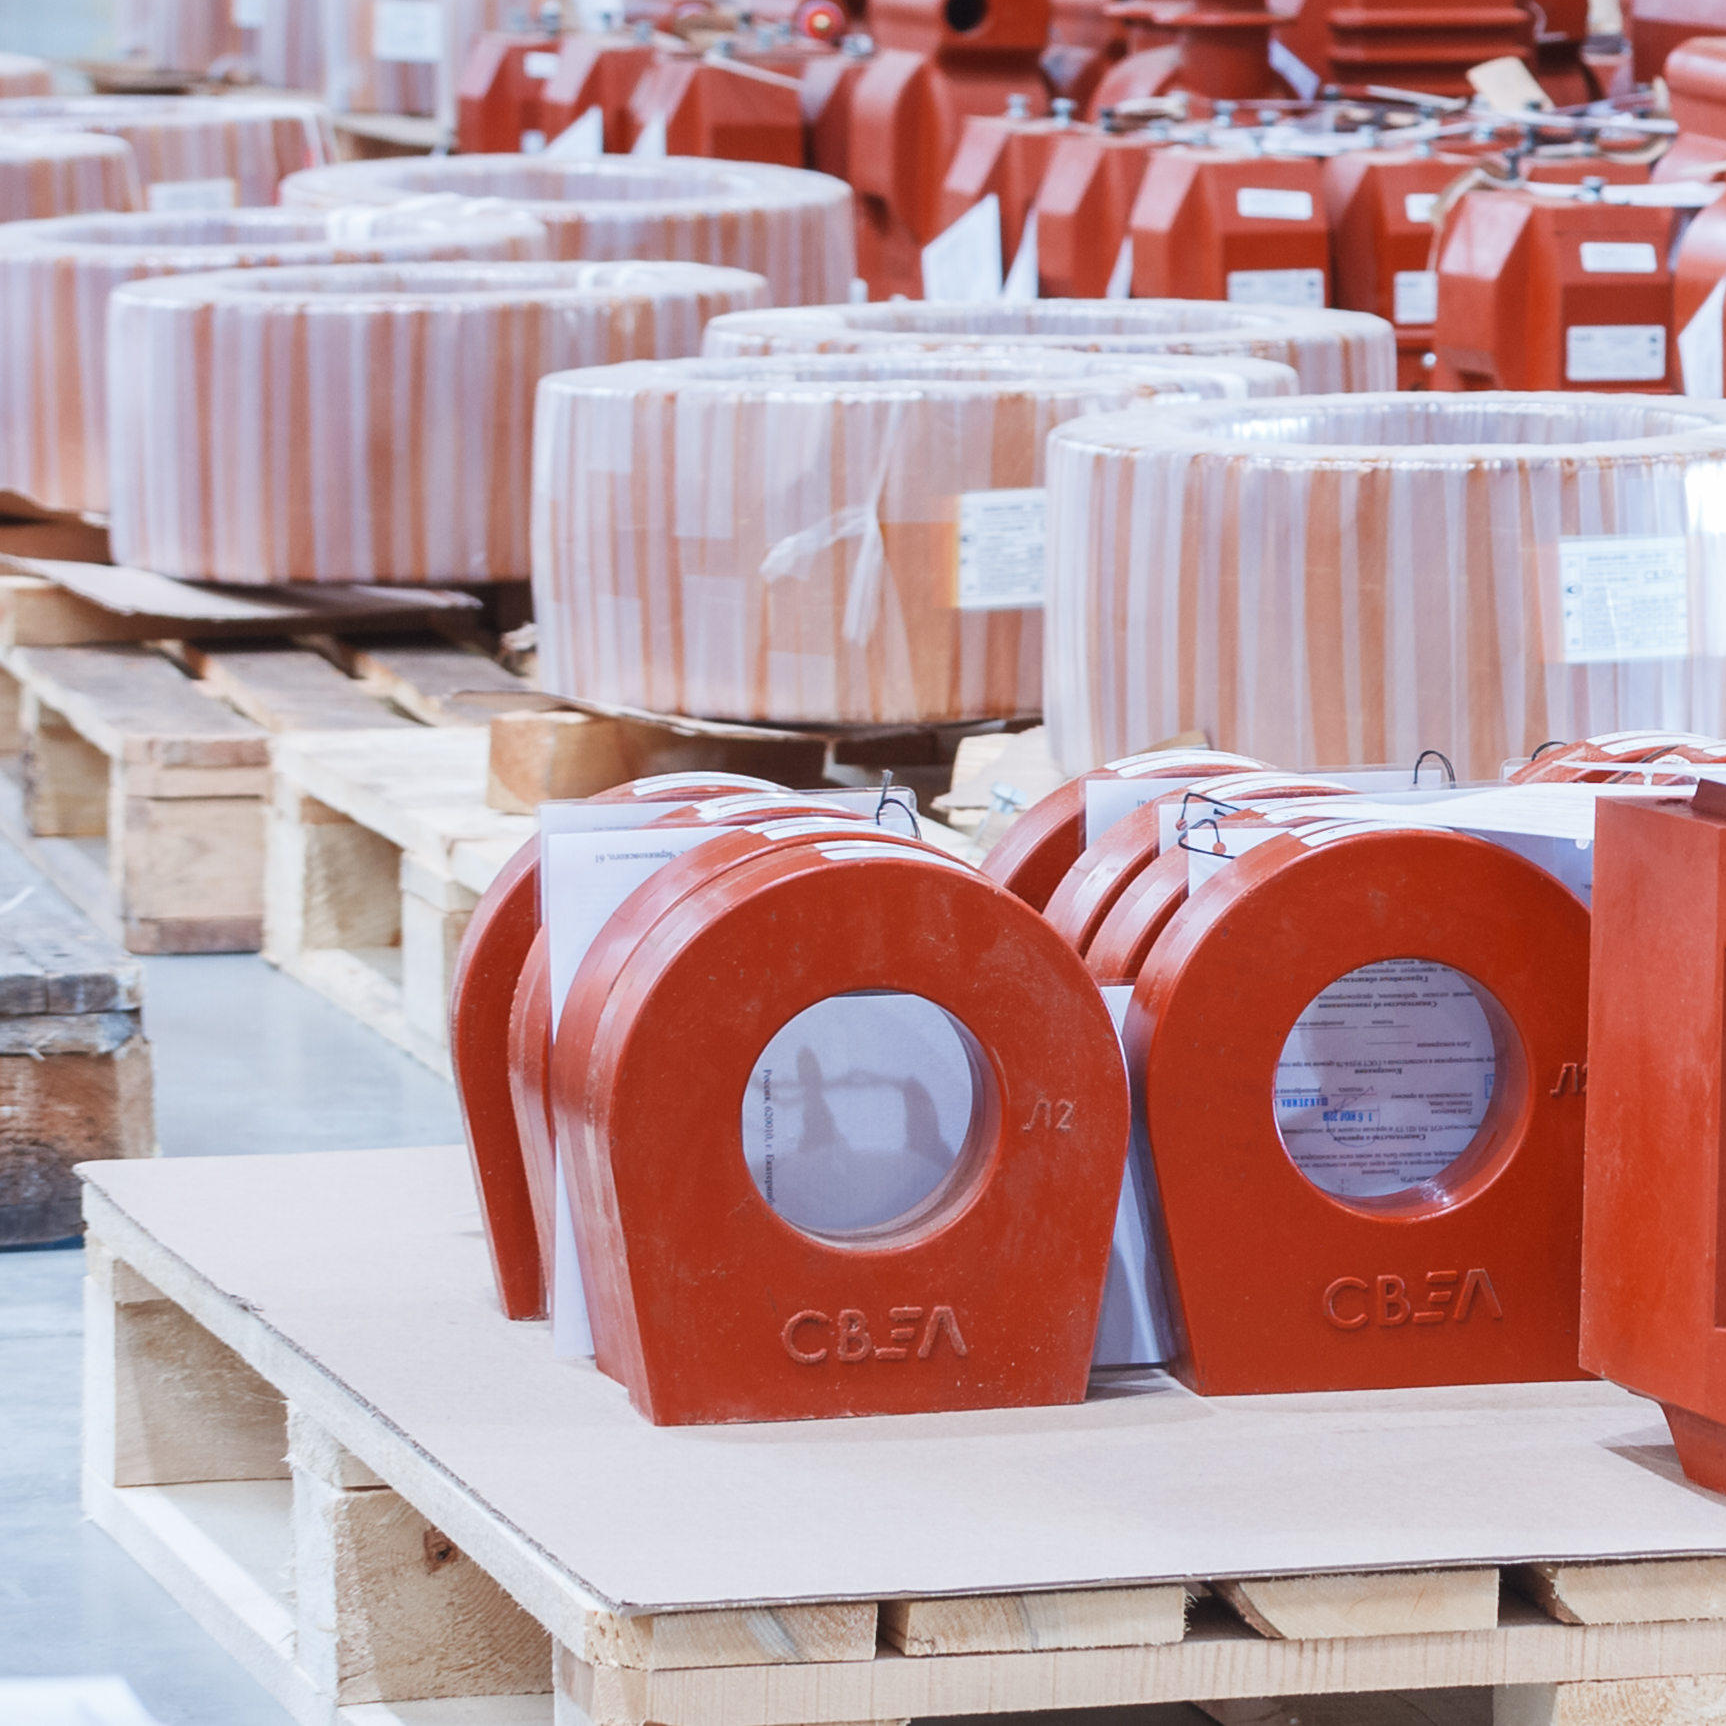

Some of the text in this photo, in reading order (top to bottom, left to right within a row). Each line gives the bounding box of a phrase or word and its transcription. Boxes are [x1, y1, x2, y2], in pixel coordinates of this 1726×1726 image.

[763, 1069, 773, 1104] Россия,
[764, 1106, 773, 1141] 620010,
[1022, 1096, 1076, 1133] Л2
